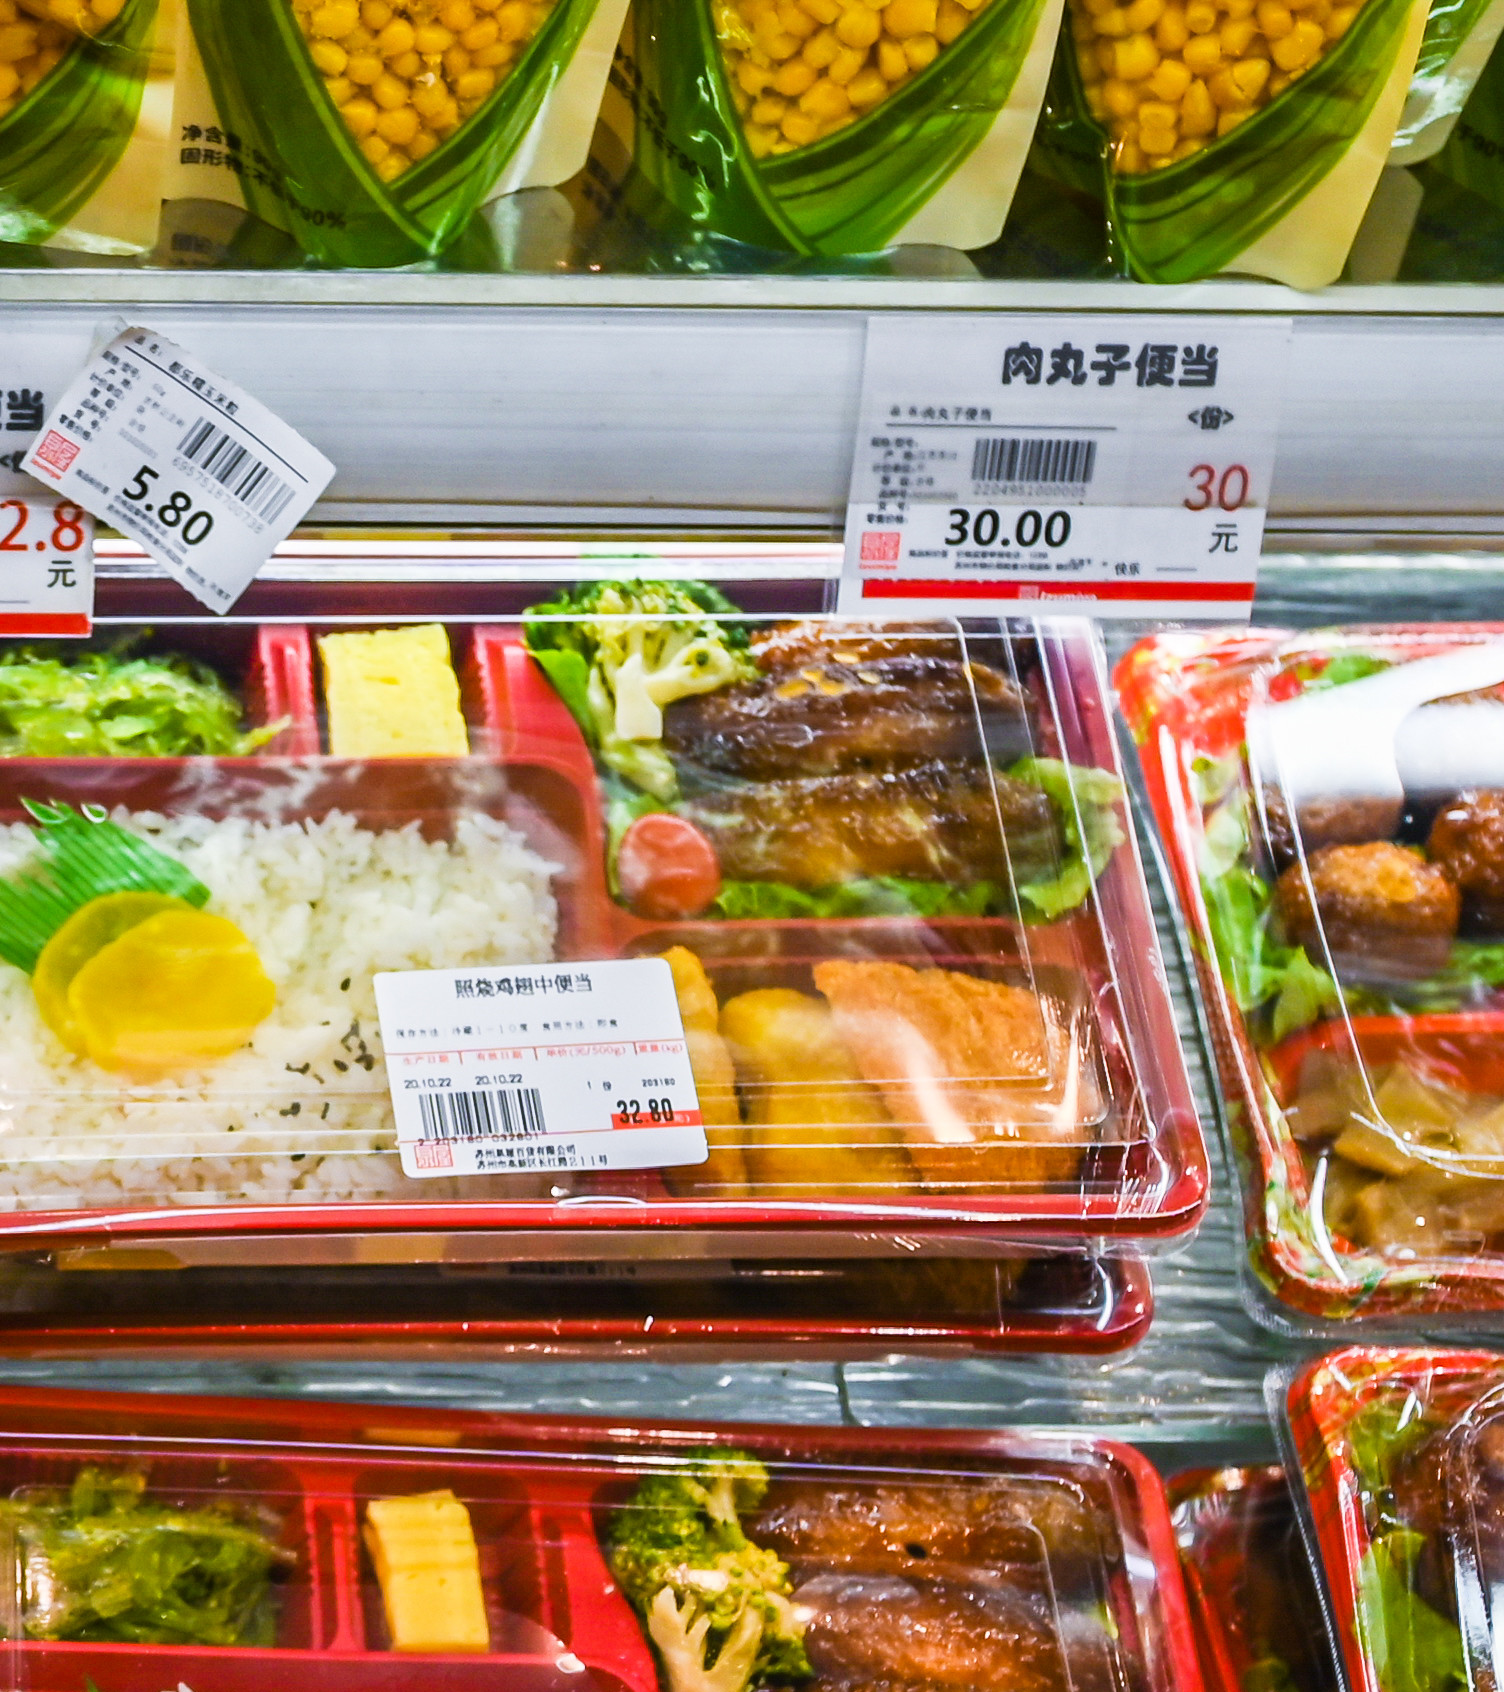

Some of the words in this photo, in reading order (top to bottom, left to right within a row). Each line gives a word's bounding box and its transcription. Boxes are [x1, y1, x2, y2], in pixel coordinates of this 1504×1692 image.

[1002, 341, 1219, 388] 肉丸子便当
[1183, 463, 1249, 511] 30
[121, 464, 215, 548] 5.80
[944, 508, 1071, 547] 30.00
[1208, 523, 1238, 553] 元
[47, 560, 77, 588] 元
[455, 973, 593, 998] 照烧鸡翅中便当
[404, 1077, 452, 1090] 20.10.22
[475, 1073, 523, 1086] 20.10.22
[617, 1098, 673, 1124] 32.80
